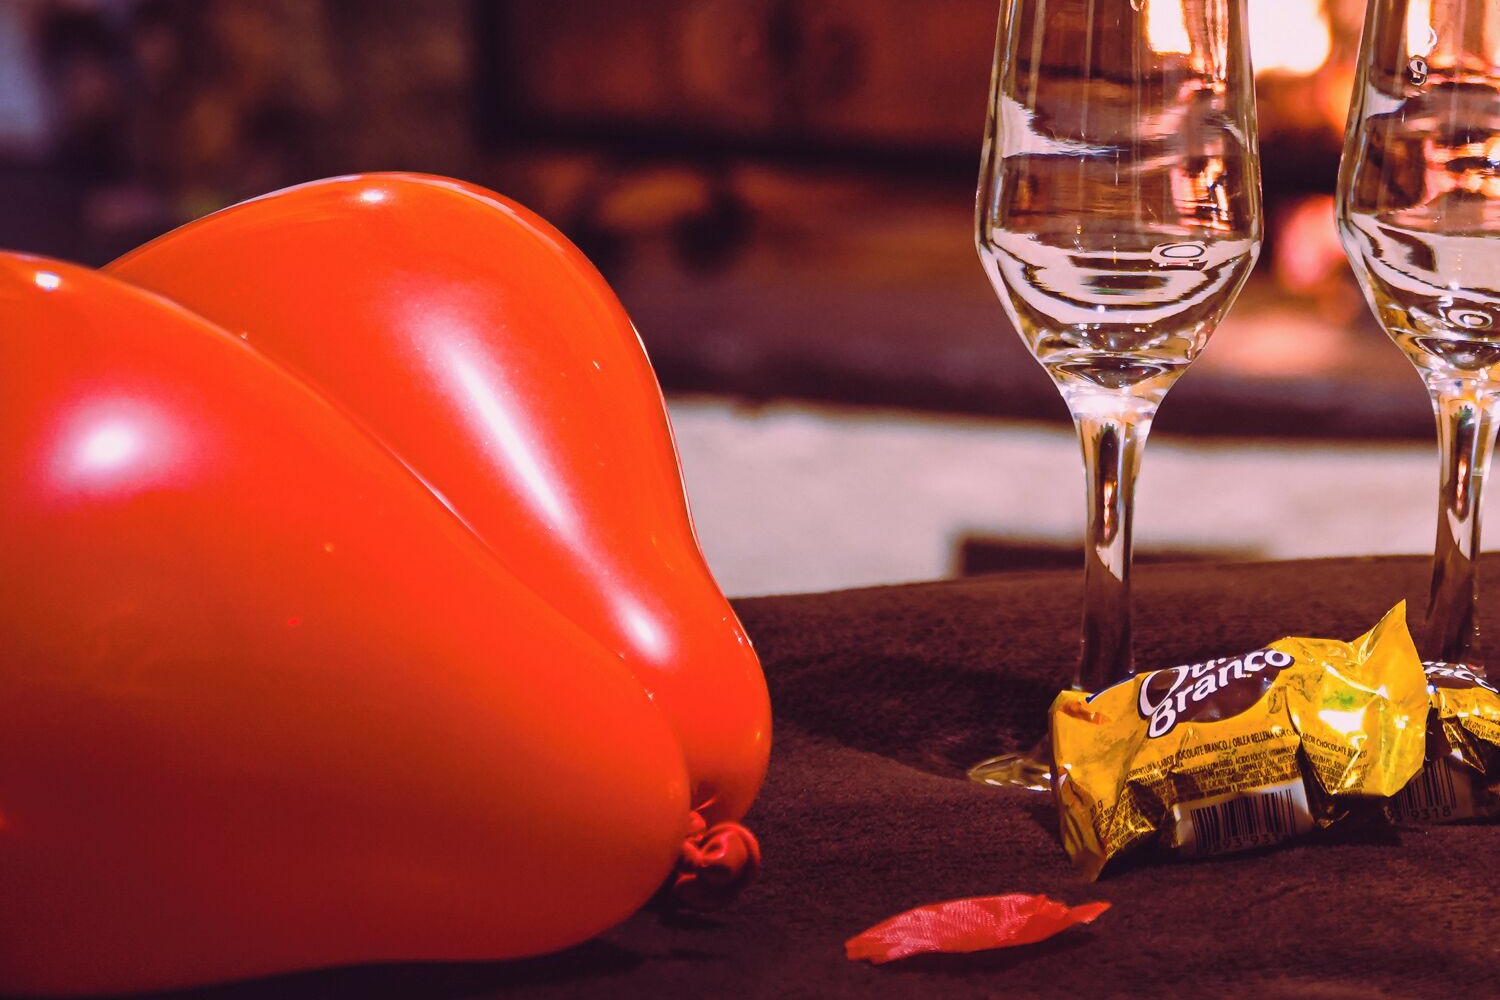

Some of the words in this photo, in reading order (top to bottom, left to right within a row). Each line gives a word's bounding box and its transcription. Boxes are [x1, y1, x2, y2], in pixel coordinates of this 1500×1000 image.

[1140, 658, 1232, 717] Ou
[1148, 650, 1292, 738] Branco
[1203, 739, 1227, 755] BRANCO
[1232, 737, 1250, 748] OBLEA
